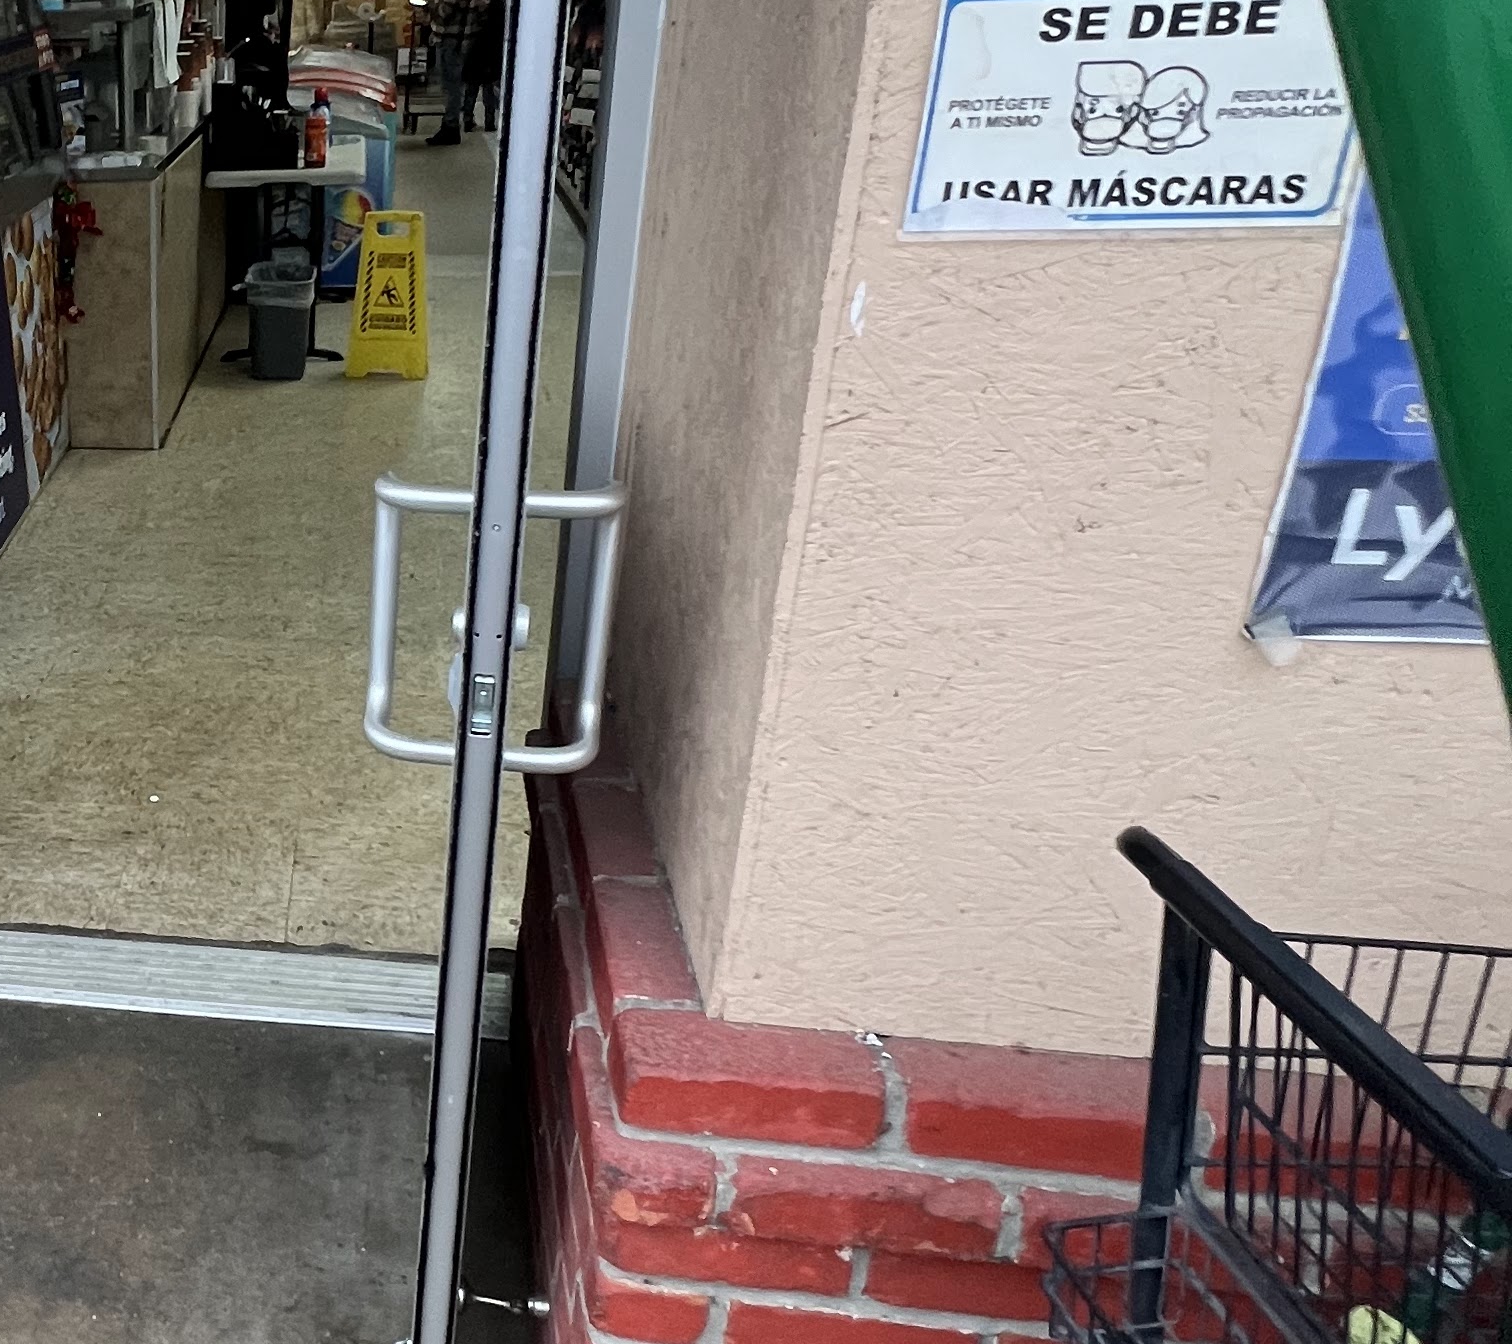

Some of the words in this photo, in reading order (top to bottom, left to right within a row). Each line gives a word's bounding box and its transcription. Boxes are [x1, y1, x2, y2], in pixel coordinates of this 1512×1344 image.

[1039, 6, 1109, 44] SE
[1128, 0, 1285, 39] DEBE
[948, 94, 1052, 114] PROTÉGETE
[1230, 89, 1307, 104] REDUCIR
[1311, 87, 1338, 102] LA
[950, 115, 965, 130] A
[966, 114, 984, 129] TI
[987, 114, 1042, 129] MISMO
[1067, 170, 1308, 208] MÁSCARAS
[1332, 488, 1460, 582] Ly
